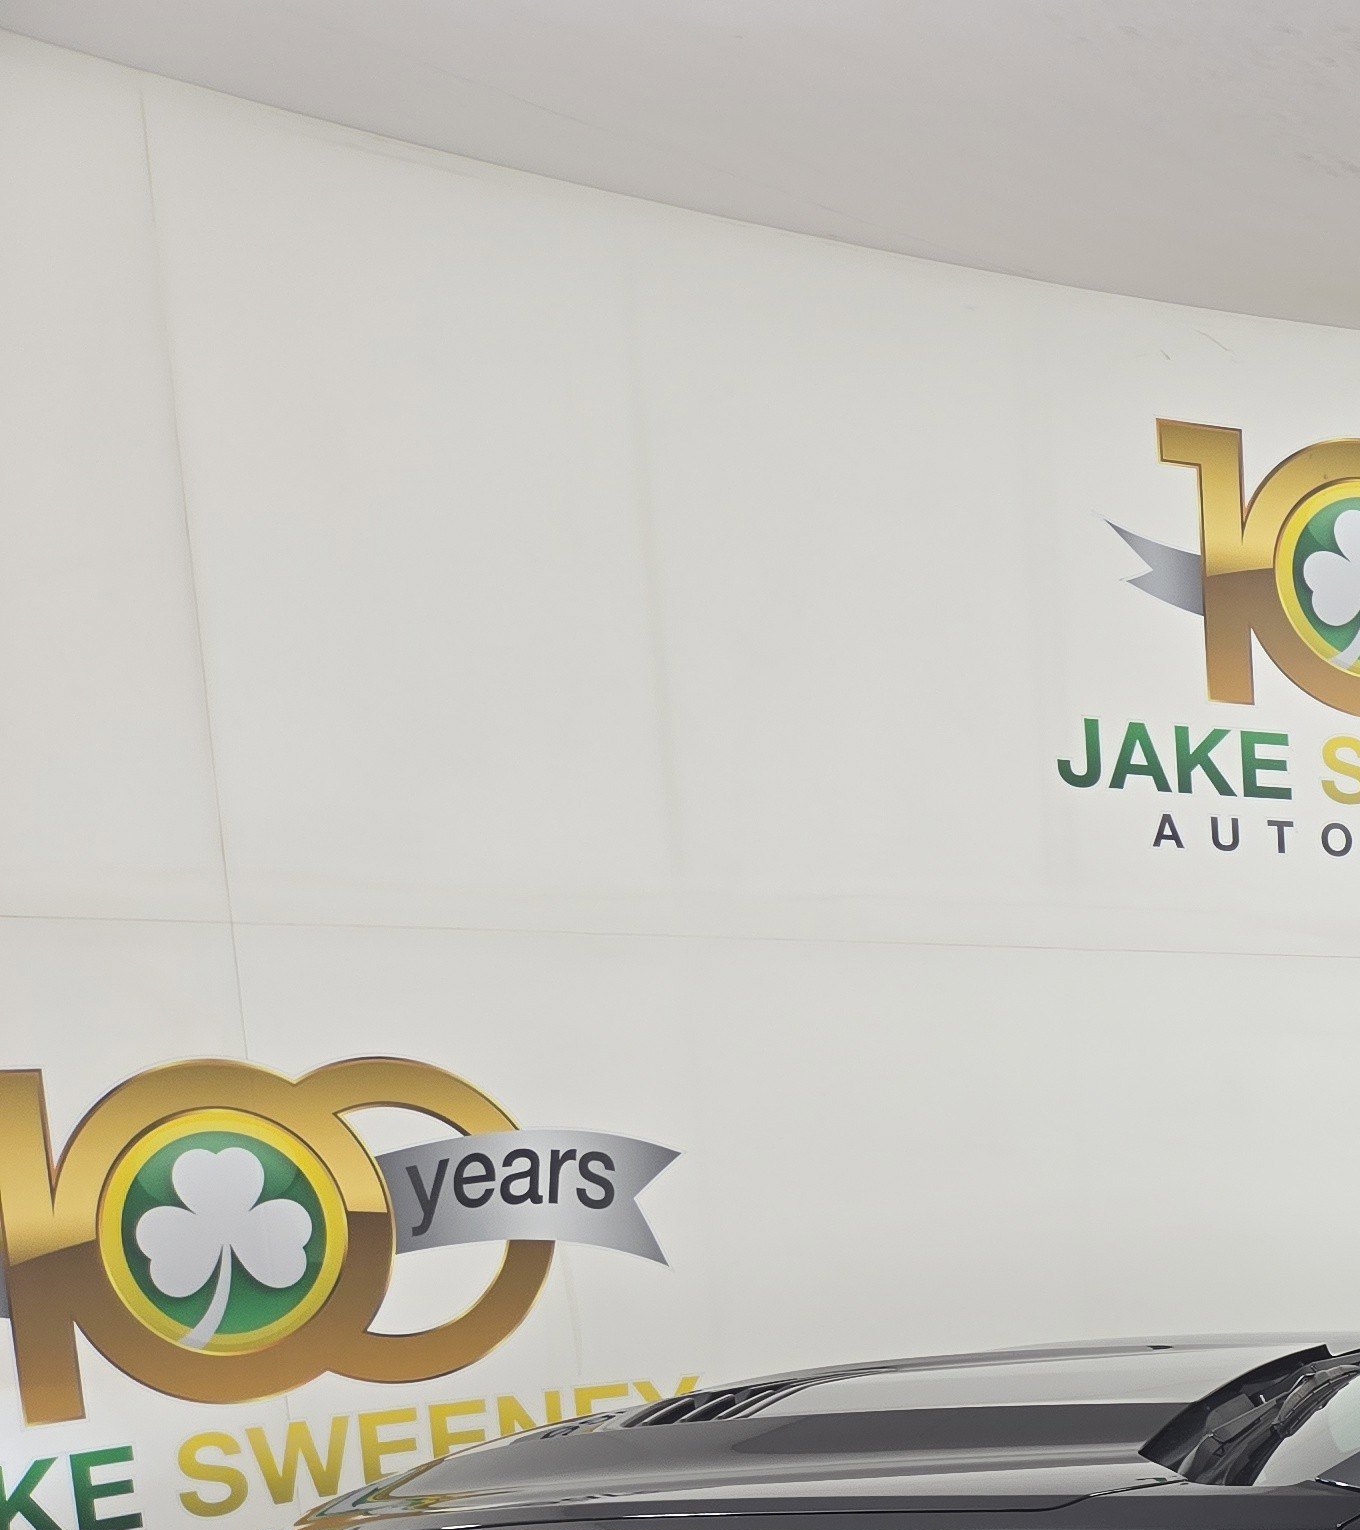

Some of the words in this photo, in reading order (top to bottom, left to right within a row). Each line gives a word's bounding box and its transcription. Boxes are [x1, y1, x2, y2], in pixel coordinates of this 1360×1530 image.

[1056, 717, 1293, 800] JAKE
[405, 1147, 616, 1238] years
[177, 1376, 700, 1517] SWEE
